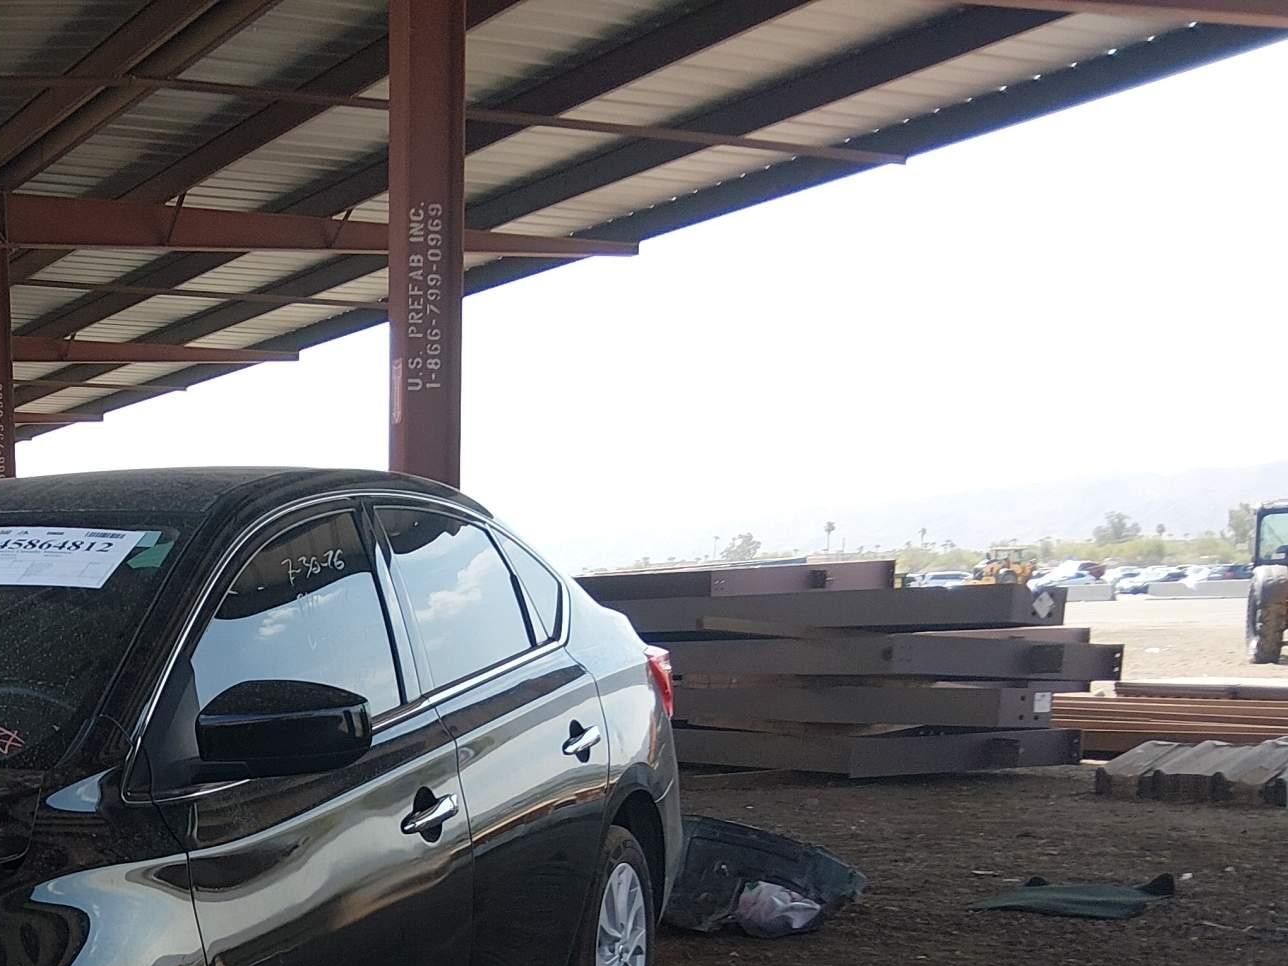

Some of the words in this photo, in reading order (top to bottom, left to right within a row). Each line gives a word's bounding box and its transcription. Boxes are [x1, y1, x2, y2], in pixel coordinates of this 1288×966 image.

[409, 201, 425, 242] INC.
[408, 254, 425, 338] PREFAB
[426, 203, 442, 389] 1-866-799-0969
[408, 351, 423, 391] U.S.
